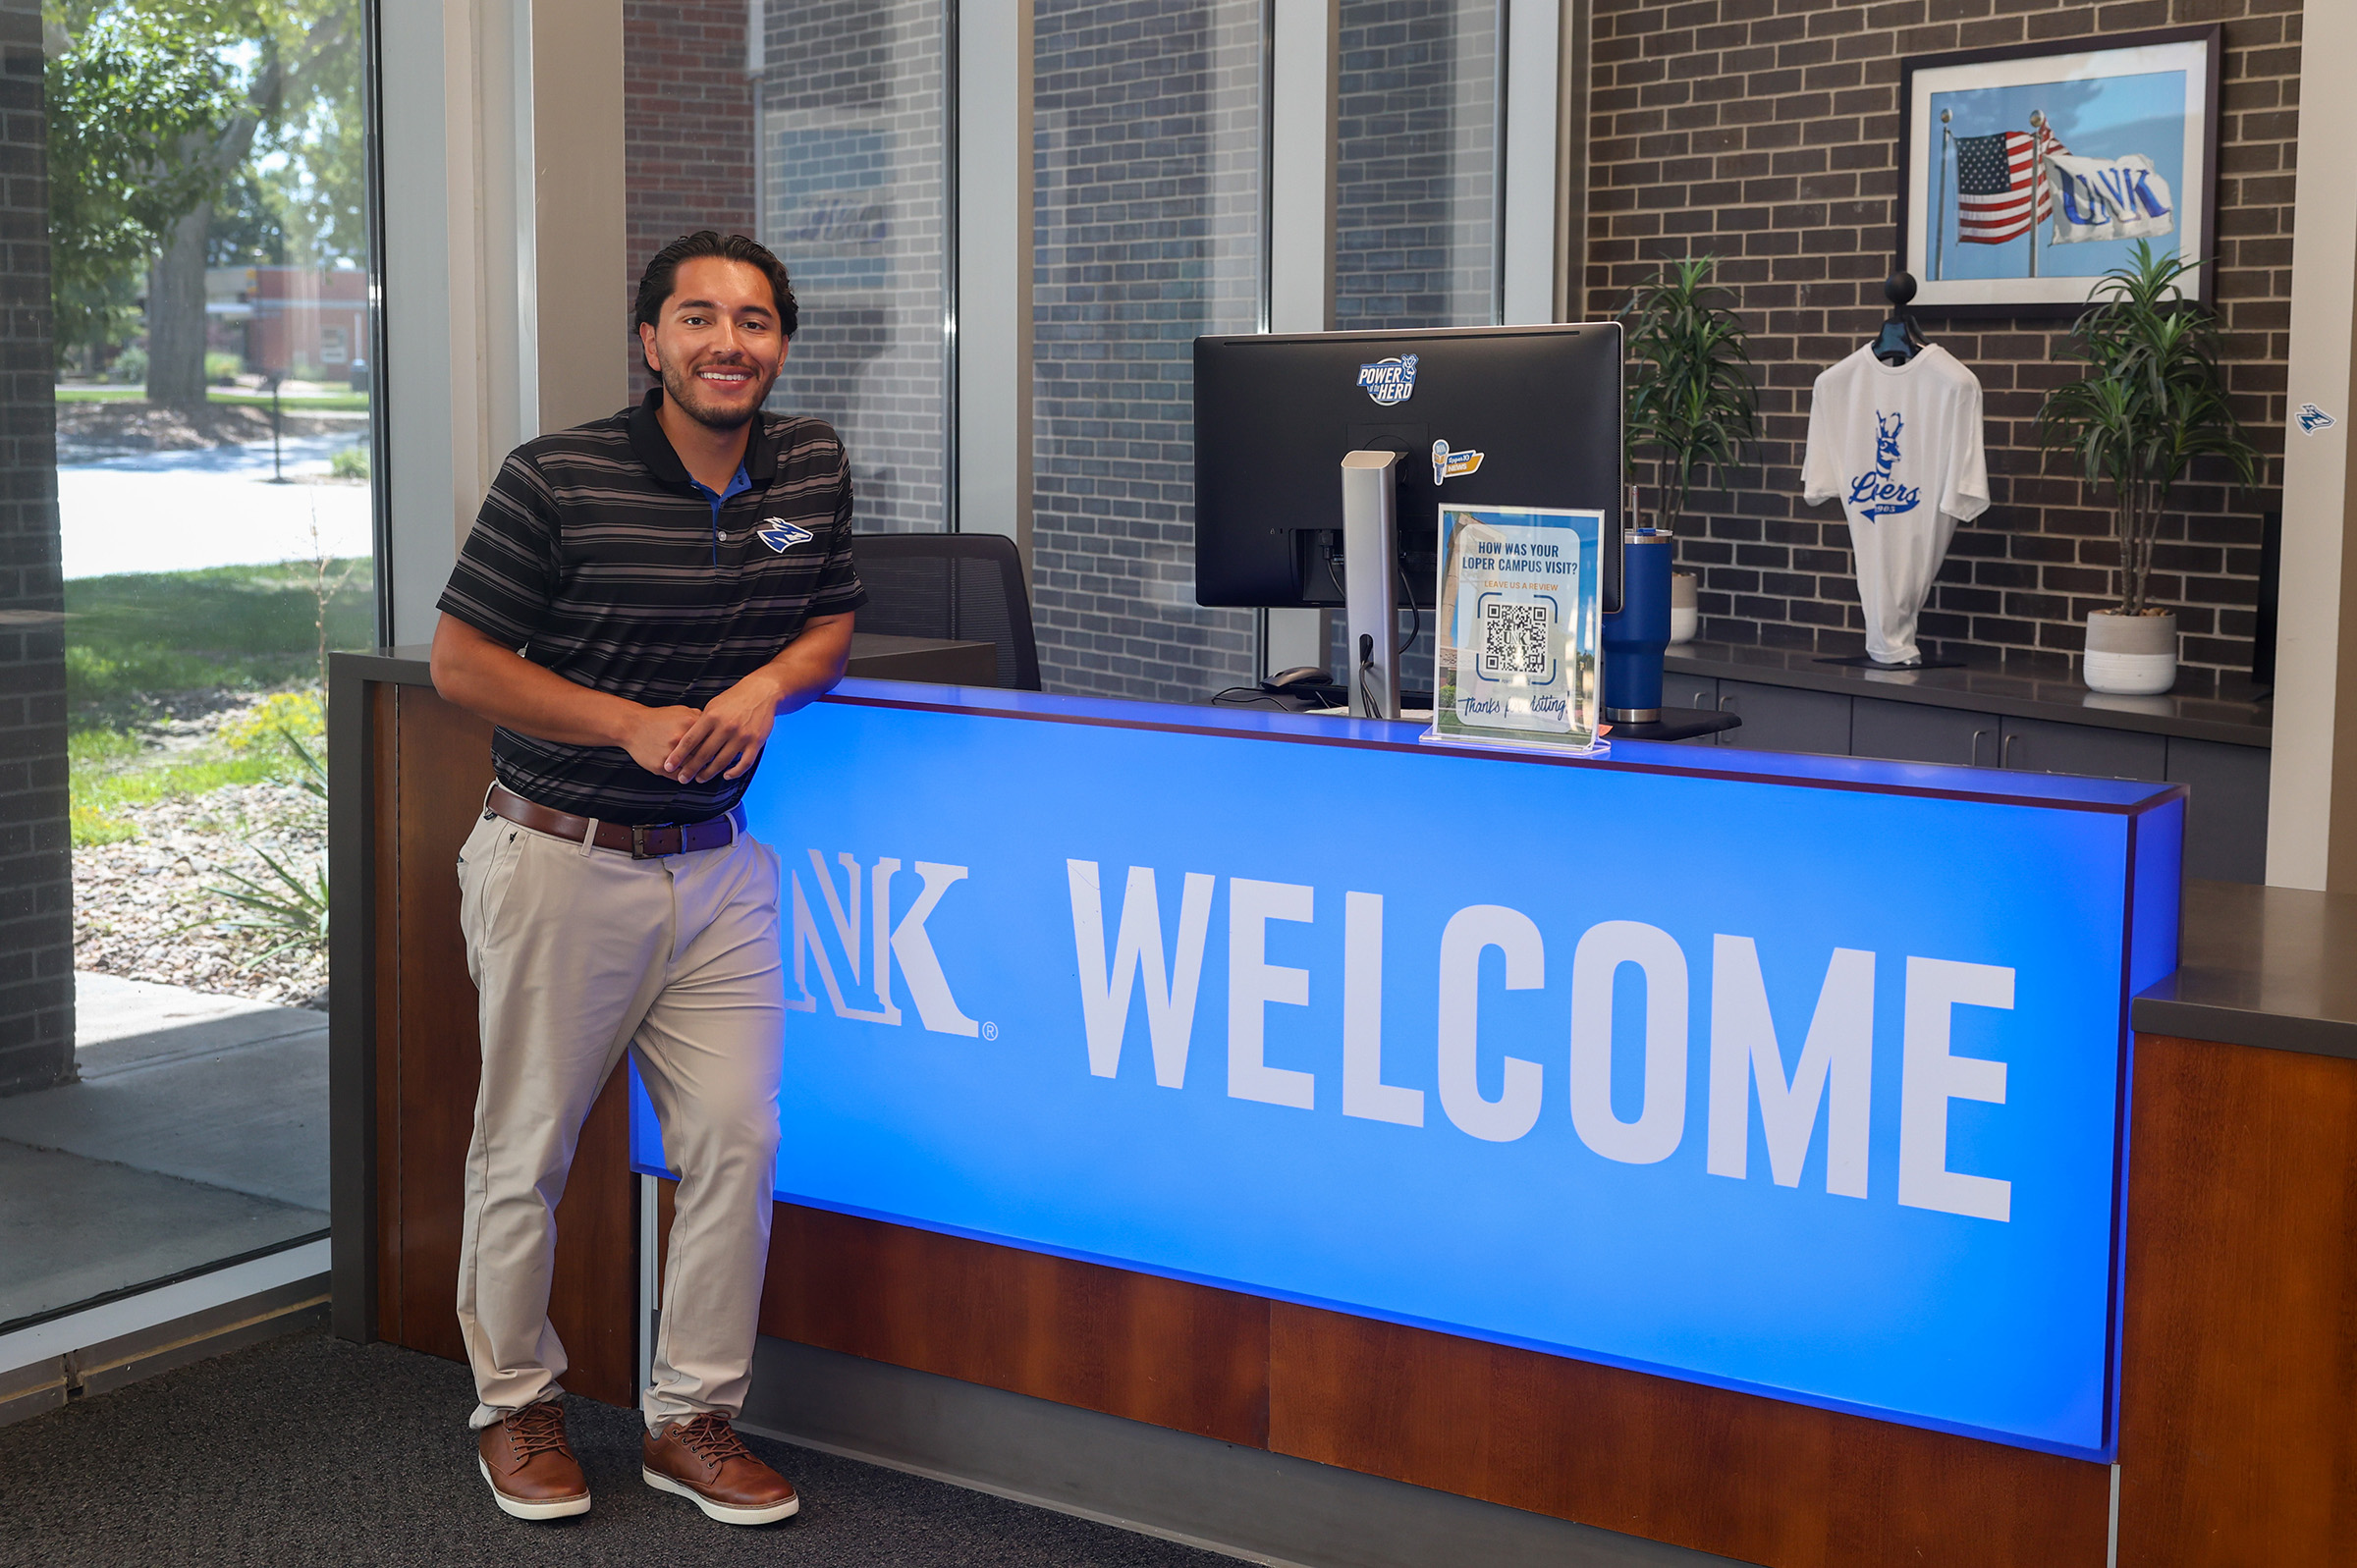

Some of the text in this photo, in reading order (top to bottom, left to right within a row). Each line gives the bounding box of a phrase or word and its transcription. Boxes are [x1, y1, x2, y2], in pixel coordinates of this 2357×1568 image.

[2055, 165, 2171, 226] UNK
[1358, 367, 1402, 385] POWER
[1377, 383, 1413, 400] HERD
[1478, 541, 1559, 558] HOW WAS YOUR
[1462, 557, 1578, 574] LOPER CAMPUS VISIT?
[1504, 631, 1527, 645] UNK
[1457, 696, 1501, 717] Thanks
[1529, 690, 1570, 721] isiting!
[781, 848, 2016, 1222] NK WELCOME
